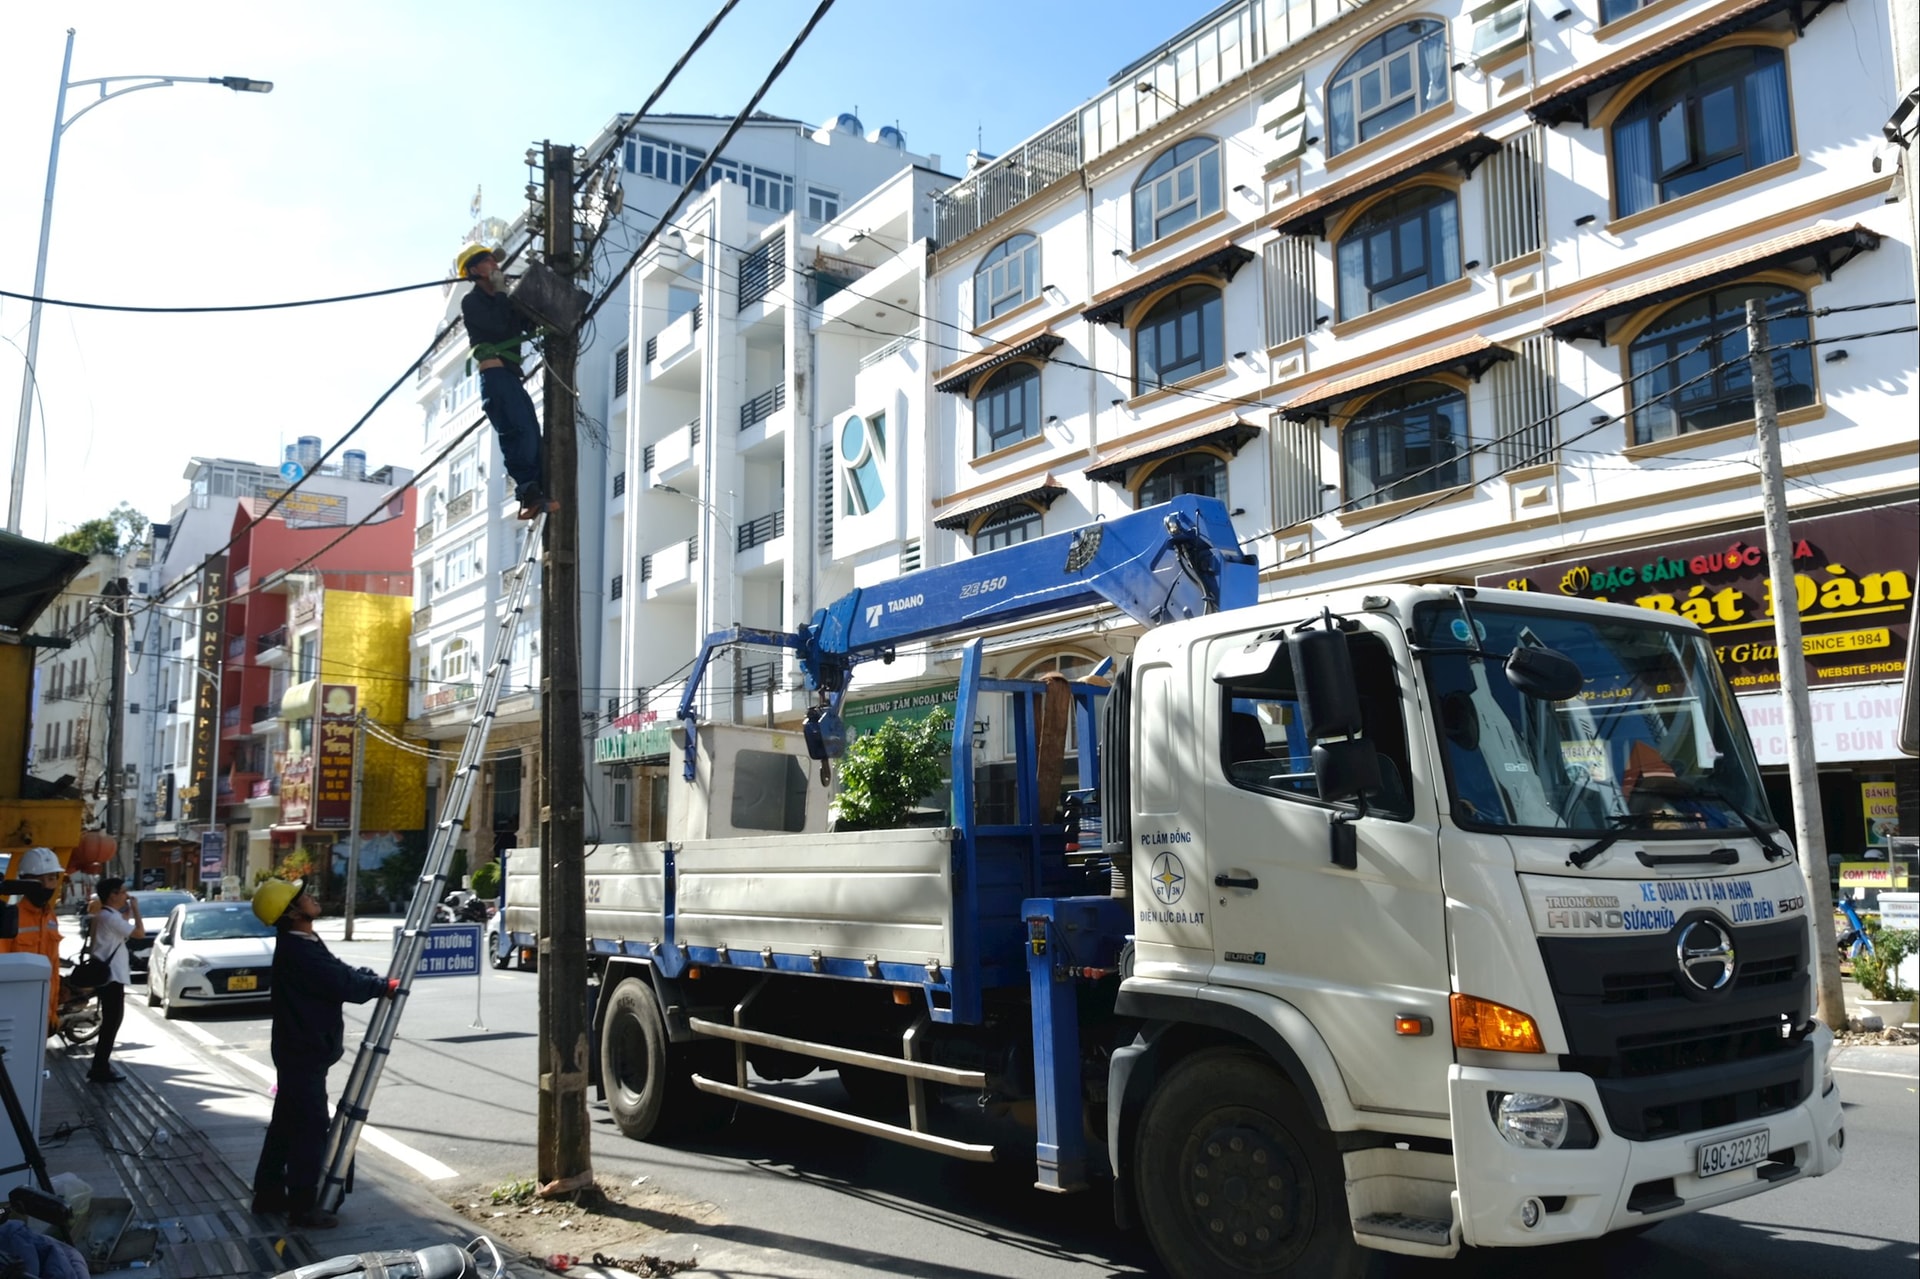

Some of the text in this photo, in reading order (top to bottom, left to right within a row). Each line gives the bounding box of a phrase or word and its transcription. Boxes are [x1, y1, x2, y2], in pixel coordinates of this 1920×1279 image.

[1590, 566, 1636, 592] ĐẶC
[1641, 556, 1686, 583] SẢN
[1690, 542, 1761, 575] QUỐC
[887, 594, 924, 613] TADANO
[1802, 632, 1882, 652] SINCE 1984
[1817, 664, 1870, 679] WEBSITE:
[864, 702, 890, 714] TRUNG
[892, 697, 910, 710] TÂM
[912, 693, 939, 707] NGOẠI
[1141, 834, 1150, 845] PC
[1152, 830, 1168, 845] LÂM
[1639, 883, 1657, 902] XE
[1778, 896, 1804, 914] 500
[1159, 910, 1175, 926] LỰC
[1176, 909, 1187, 923] ĐÀ
[1189, 912, 1204, 927] LẠT
[1548, 911, 1623, 929] HINO
[433, 931, 472, 949] TRƯỜNG
[430, 957, 446, 971] THI
[447, 954, 474, 970] CÔNG
